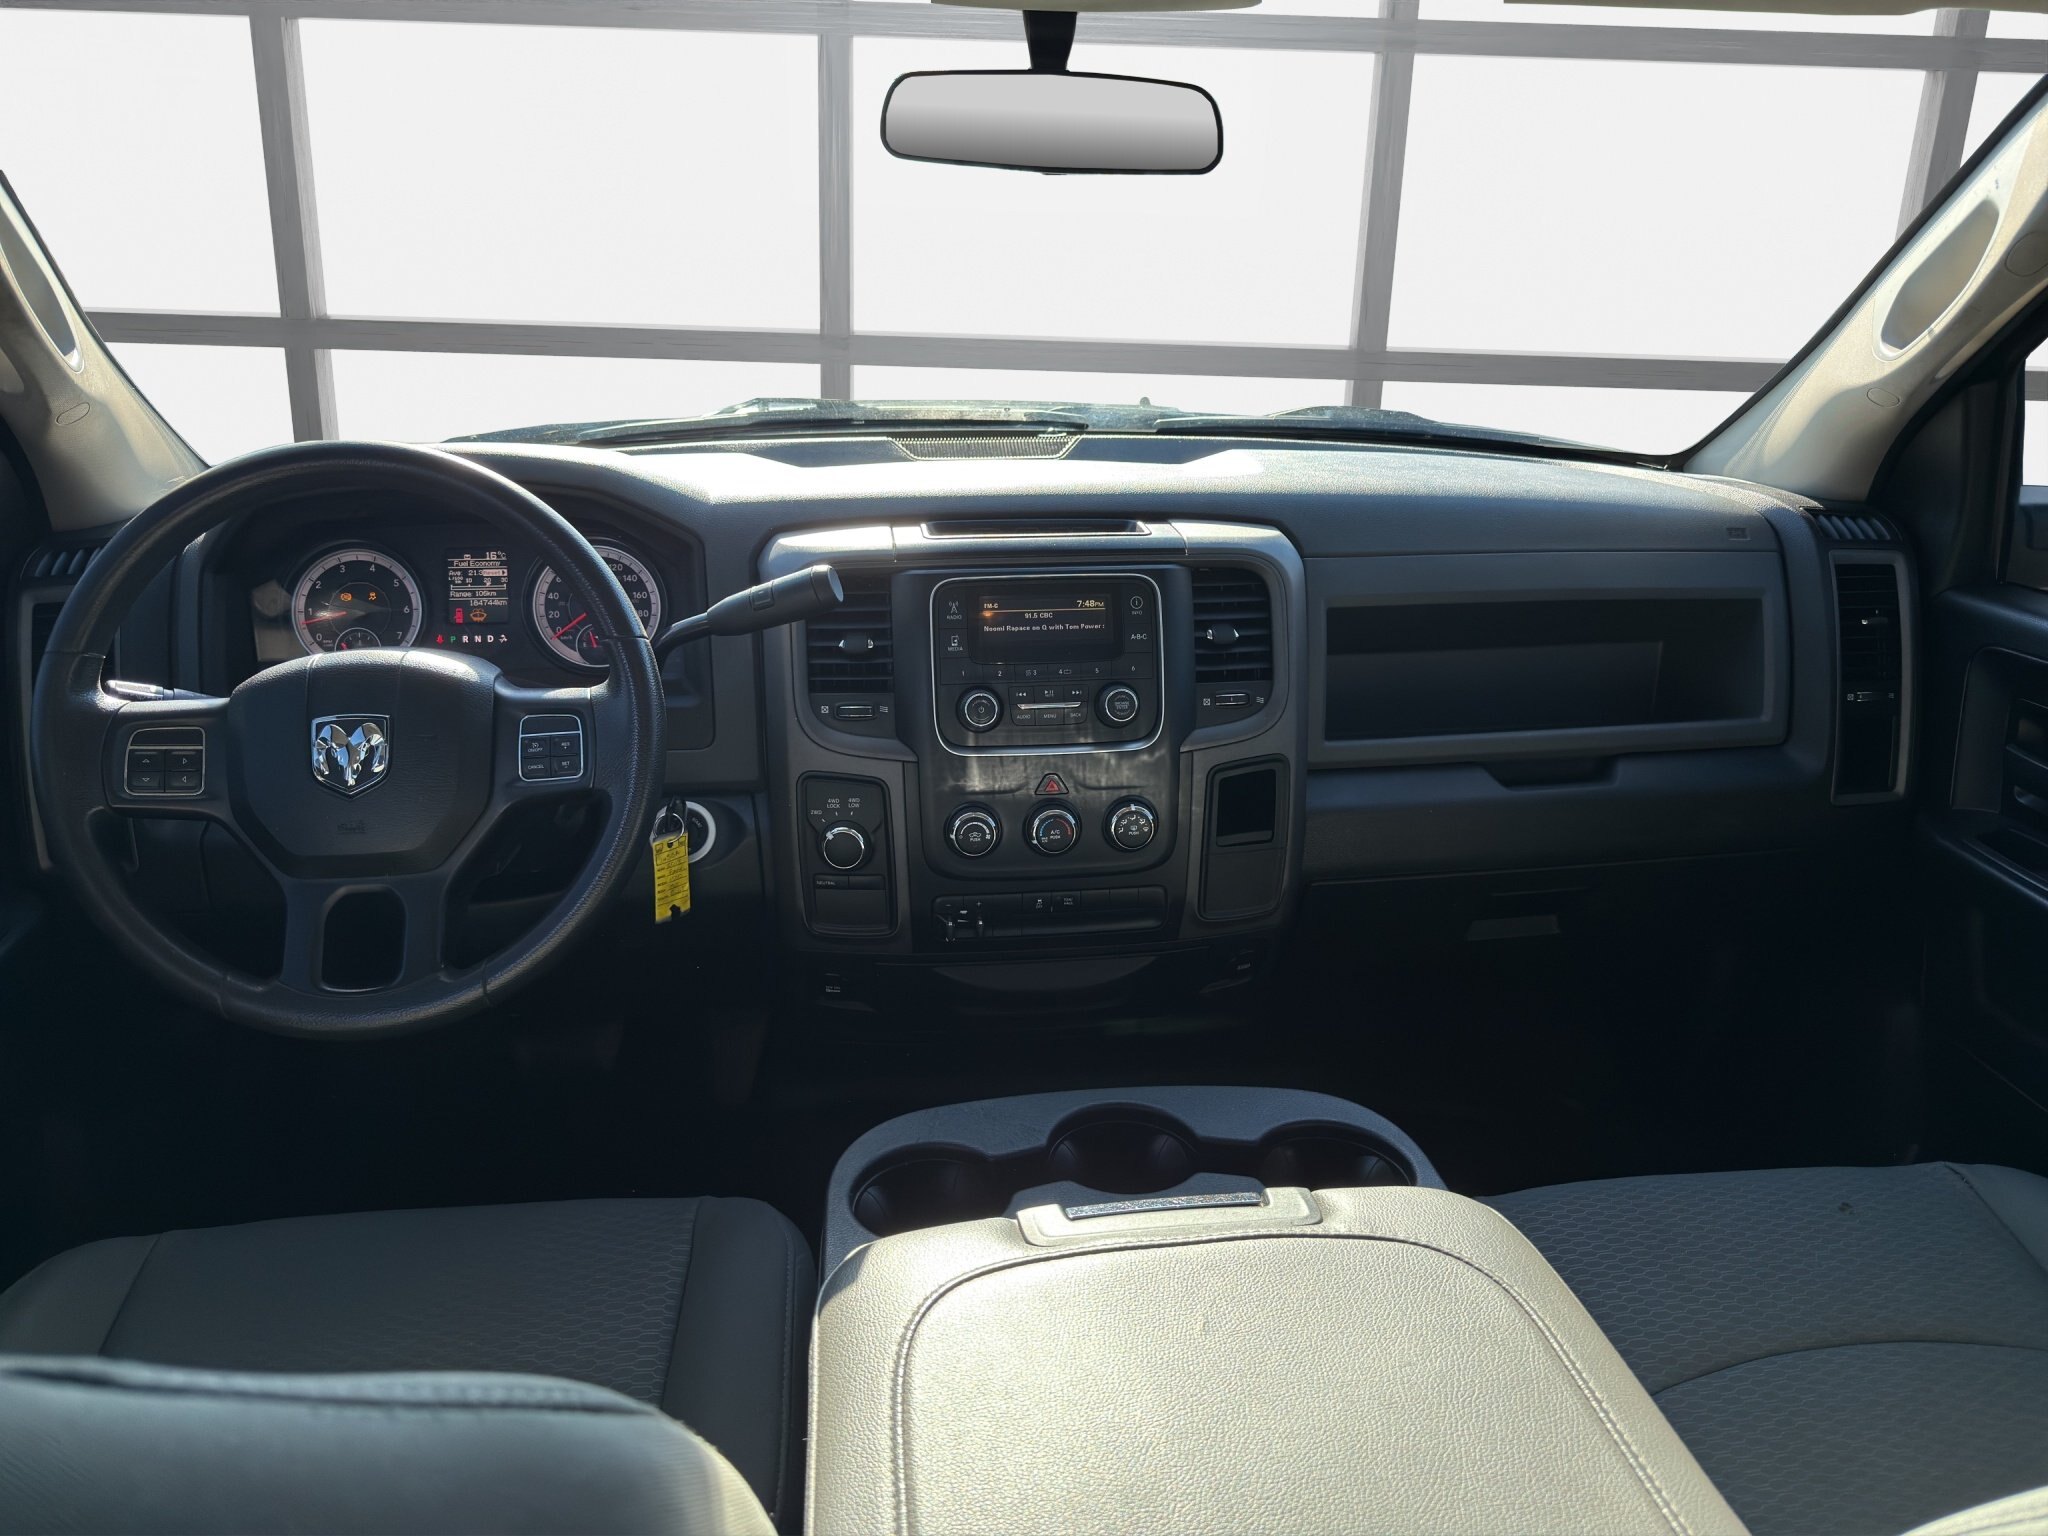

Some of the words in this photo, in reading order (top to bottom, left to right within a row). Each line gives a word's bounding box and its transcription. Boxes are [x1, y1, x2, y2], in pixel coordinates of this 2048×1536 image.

[340, 565, 345, 573] 3
[370, 564, 376, 573] 4
[315, 581, 322, 589] 2
[393, 579, 400, 587] 5
[632, 591, 648, 599] 160
[403, 606, 410, 614] 6
[316, 633, 322, 641] 0
[396, 631, 403, 640] 7
[450, 635, 456, 643] P
[462, 635, 469, 643] R
[475, 635, 482, 643] N
[487, 635, 494, 643] D
